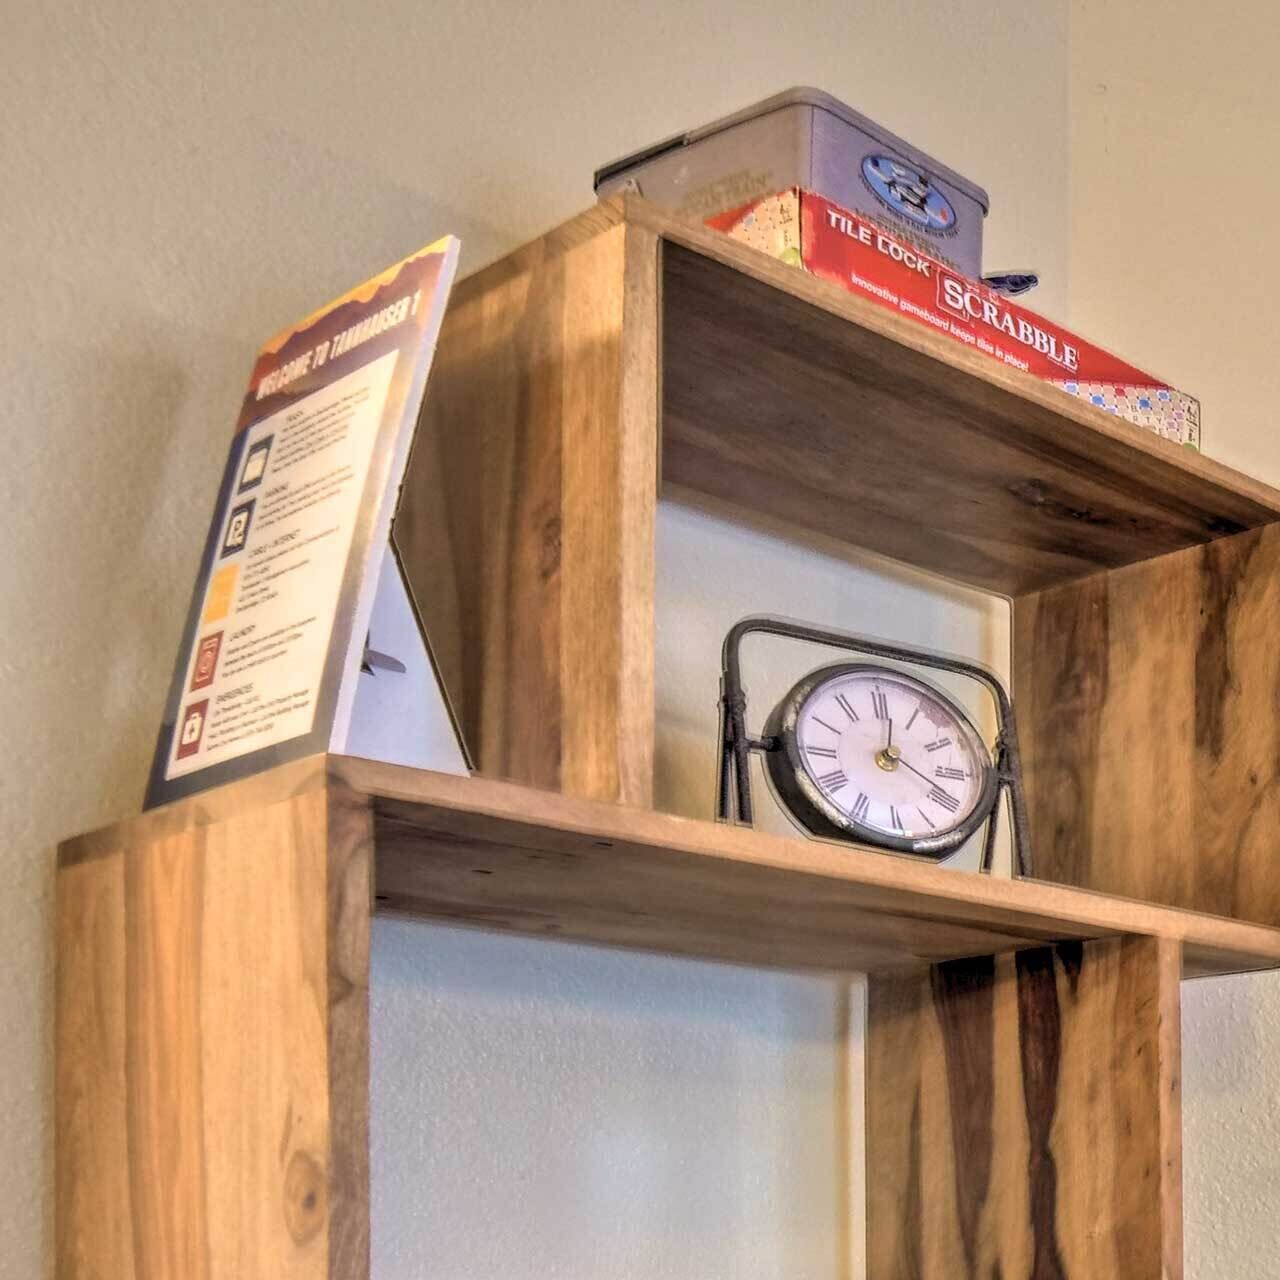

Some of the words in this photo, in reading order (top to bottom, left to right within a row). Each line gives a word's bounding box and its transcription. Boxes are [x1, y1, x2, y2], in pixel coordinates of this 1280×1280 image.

[827, 209, 872, 246] TILE
[877, 235, 931, 277] LOCK
[852, 273, 899, 305] Innovative
[900, 300, 950, 331] gameboard
[950, 322, 975, 346] keeps
[976, 337, 994, 355] tiles
[995, 345, 1004, 359] in
[1004, 350, 1030, 373] place!
[943, 277, 1079, 371] SCRABBLE
